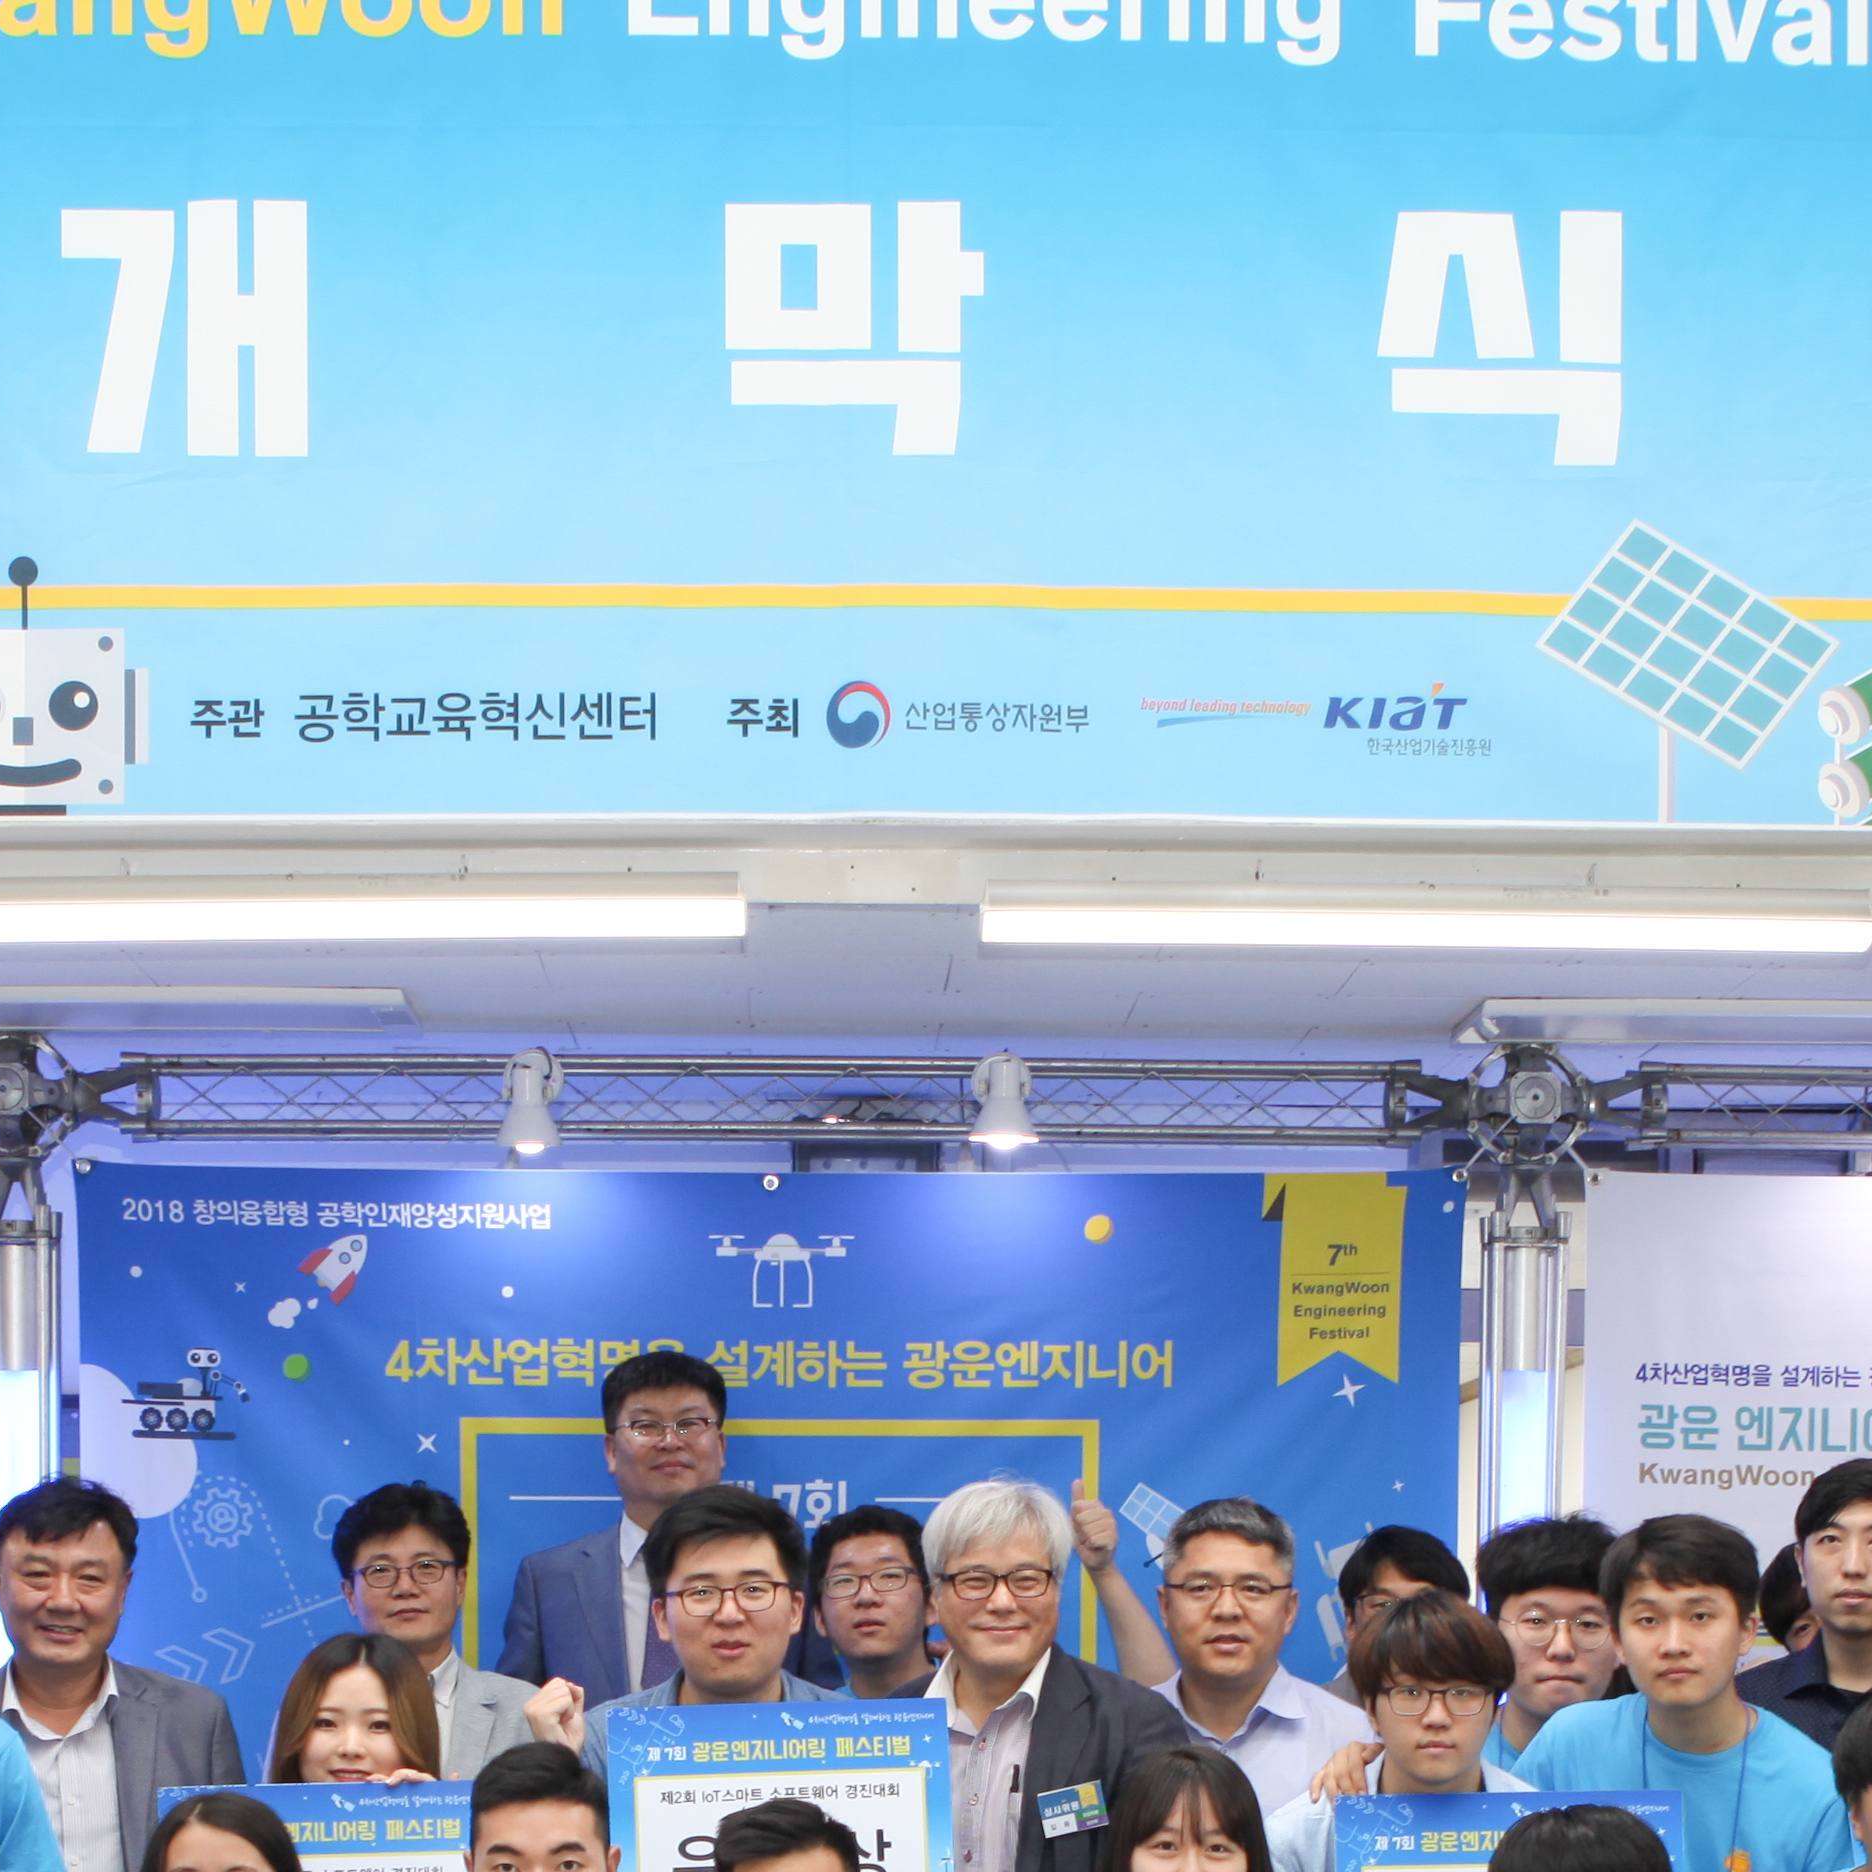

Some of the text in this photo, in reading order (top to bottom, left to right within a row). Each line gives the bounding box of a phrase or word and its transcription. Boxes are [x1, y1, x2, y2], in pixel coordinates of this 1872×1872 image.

[189, 691, 658, 743] 주관 공학교육혁신센터
[726, 697, 800, 738] 주최
[904, 702, 1090, 733] 산업통상자원부
[1140, 697, 1312, 717] beyond leading technology
[1366, 737, 1492, 757] 한국산업기술진흥원
[122, 1198, 552, 1230] 2018 창의융합형 공학인재양성지원사업
[1326, 1241, 1358, 1267] 7th
[1290, 1279, 1390, 1297] KwangWoon
[1292, 1302, 1386, 1321] Engineering
[1308, 1325, 1370, 1341] Festival
[705, 1338, 887, 1388] 설계하는
[902, 1338, 1174, 1389] 광운엔지니어
[1635, 1361, 1772, 1388] 4차산업혁명을
[1780, 1364, 1862, 1389] 설계하는
[1637, 1403, 1720, 1451] 광운
[693, 1736, 911, 1762] 광운엔지니어링 페스티벌
[660, 1783, 901, 1806] 제2회 IoT스마트 소프트웨어 경진대회
